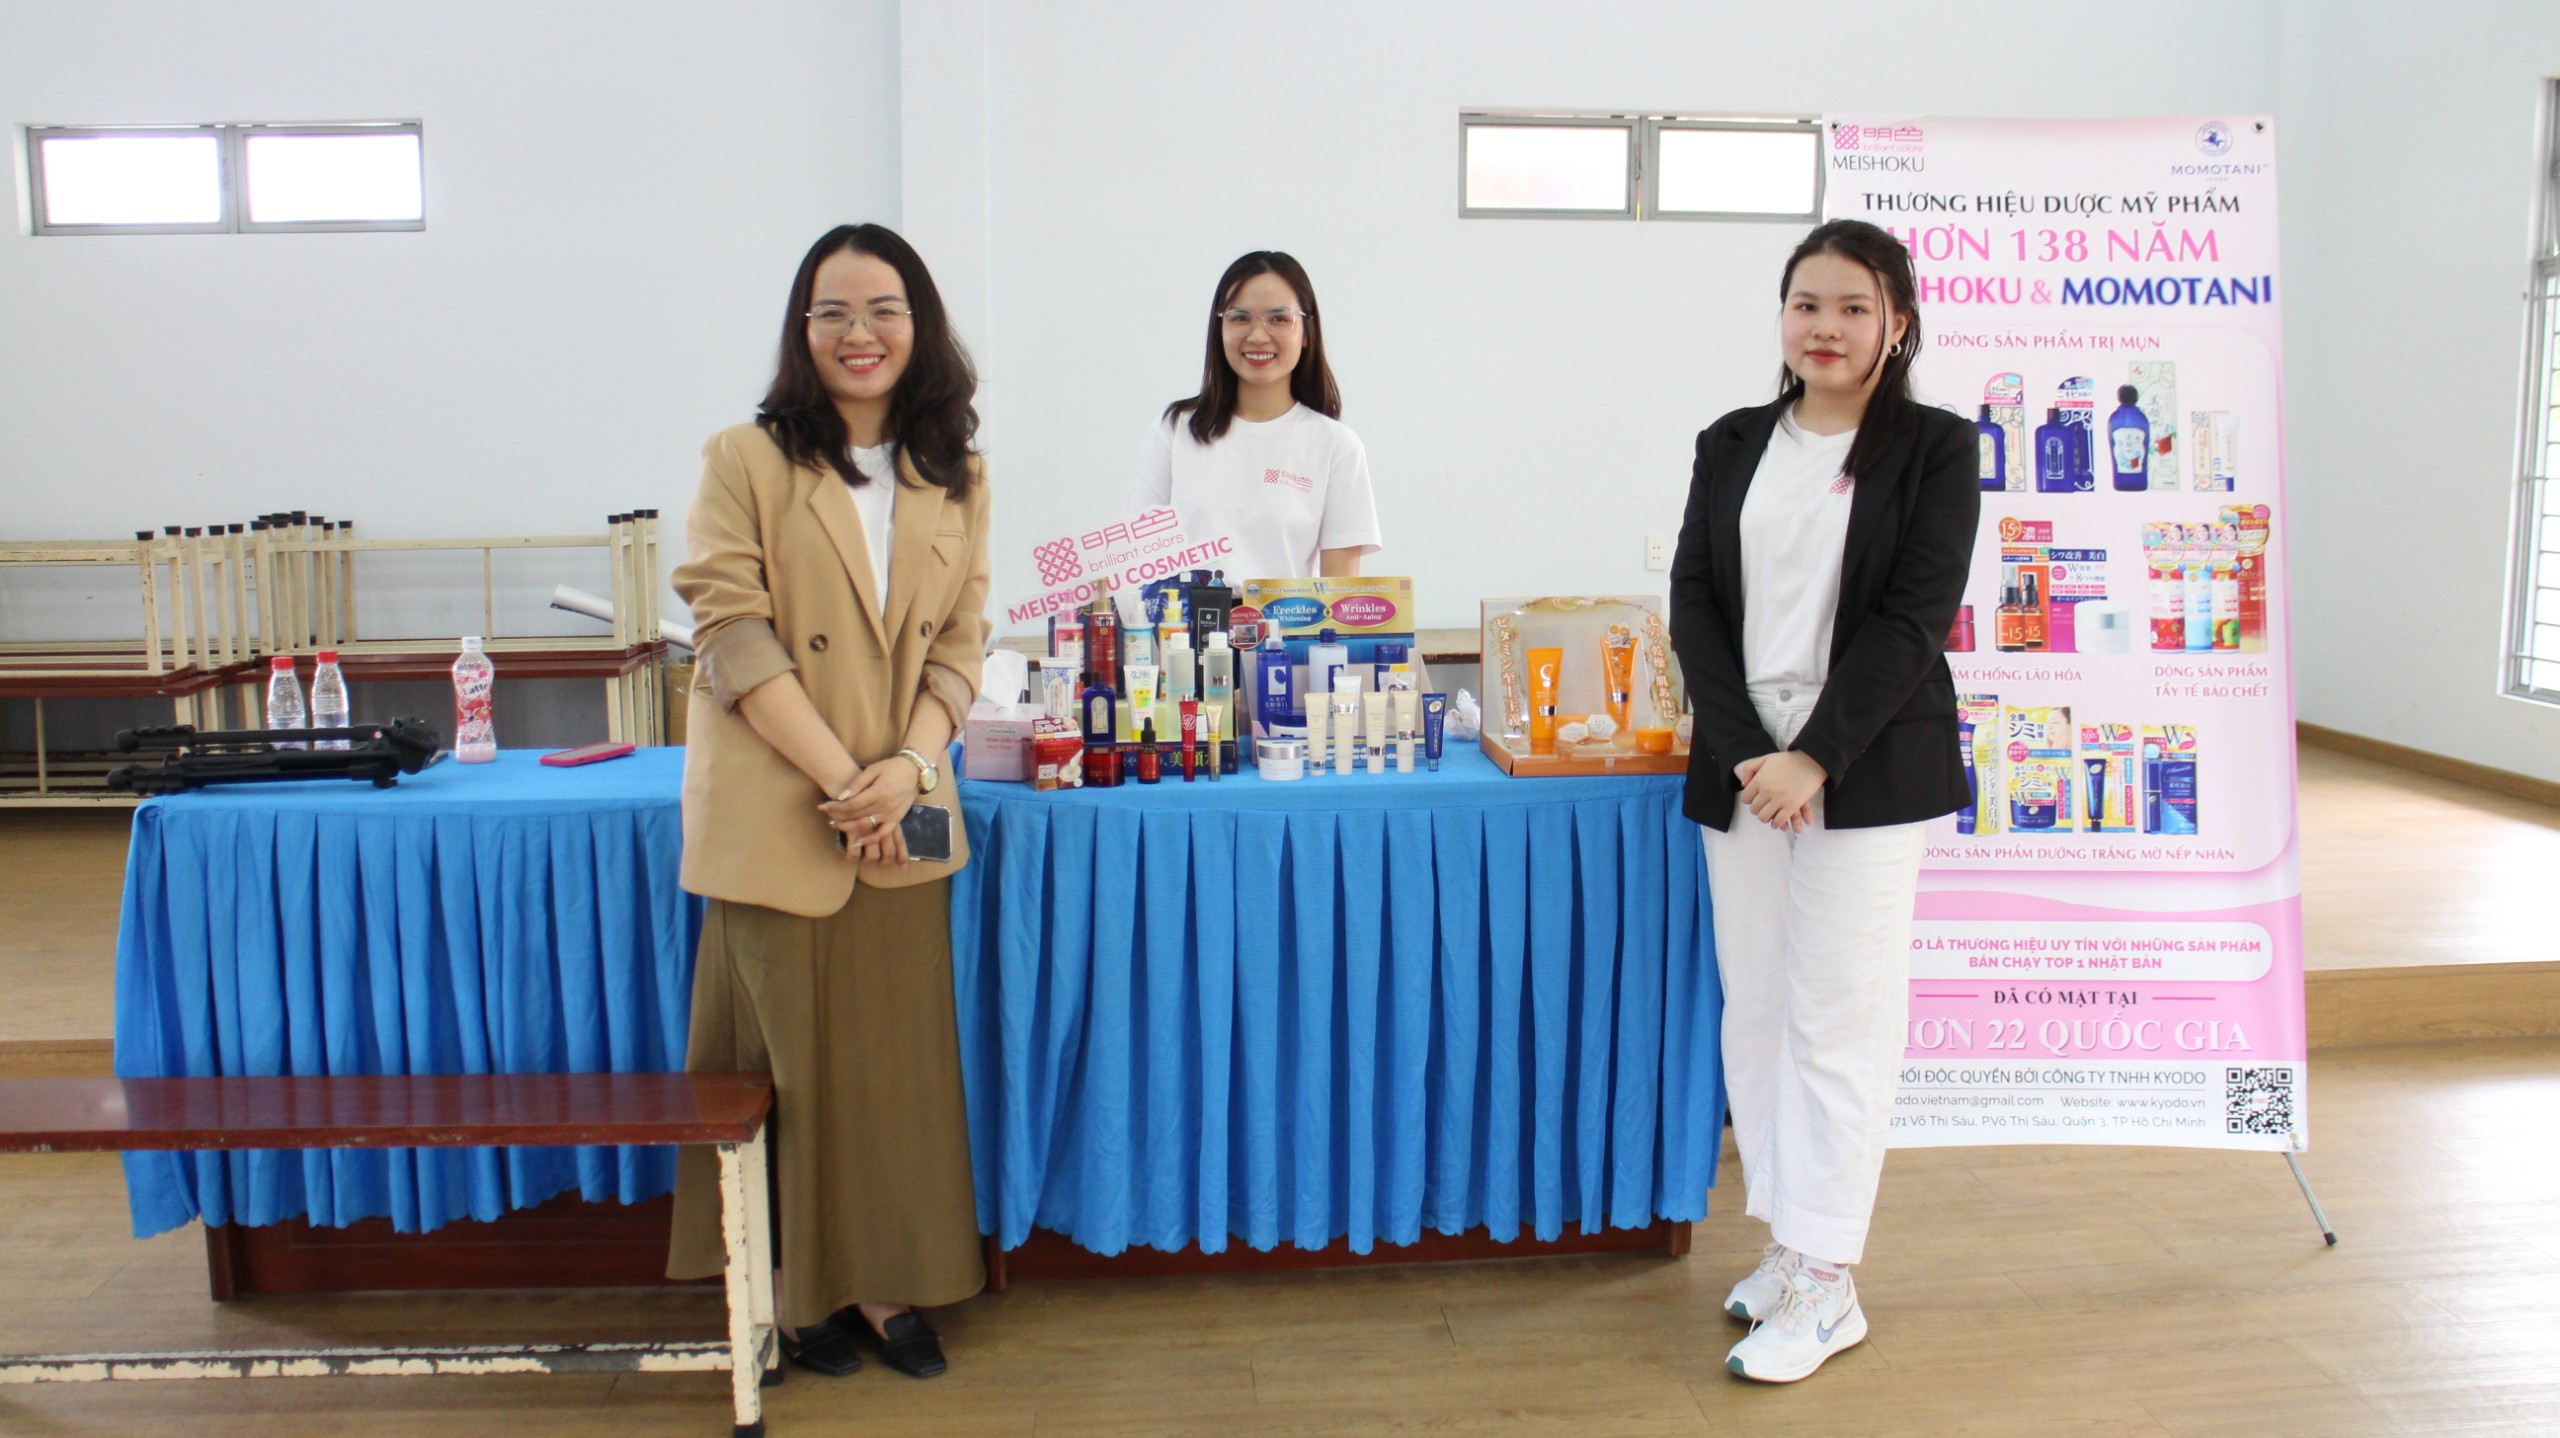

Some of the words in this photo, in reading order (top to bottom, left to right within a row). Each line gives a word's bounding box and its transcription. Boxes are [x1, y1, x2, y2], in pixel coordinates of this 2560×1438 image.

[1832, 155, 1925, 172] MEISHOKU
[1862, 191, 1967, 212] THƯƠNG
[1976, 190, 2035, 217] HIỆU
[2044, 192, 2112, 218] DƯỢC
[2121, 191, 2158, 213] MỸ
[2010, 229, 2088, 262] 138
[2107, 220, 2219, 262] NĂM
[1920, 276, 2022, 304] HOKU
[2031, 279, 2052, 304] &
[2062, 275, 2272, 305] MOMOTANI
[1937, 331, 1988, 348] DÒNG
[1994, 330, 2028, 348] SẢN
[2033, 329, 2083, 349] PHẨM
[2089, 336, 2114, 352] TRỊ
[2120, 336, 2160, 352] MỤN
[1088, 546, 1140, 572] brilliant
[1142, 534, 1185, 555] colors
[1125, 536, 1233, 585] COSMETIC
[1340, 603, 1387, 613] Wrinkles
[1950, 664, 1969, 680] ẨM
[1973, 665, 2022, 680] CHỐNG
[2026, 667, 2050, 681] LÃO
[2054, 667, 2082, 681] HÓA
[2154, 664, 2194, 677] DÒNG
[2198, 663, 2223, 677] SẢN
[462, 683, 488, 696] Latte
[2154, 681, 2179, 697] TẨY
[2184, 681, 2199, 697] TẾ
[2202, 684, 2229, 698] BÀO
[2232, 681, 2268, 697] CHẾT
[1964, 844, 1990, 858] SẢN
[1995, 843, 2033, 859] PHẨM
[2037, 846, 2086, 859] DƯỠNG
[2091, 844, 2136, 860] TRẮNG
[2140, 846, 2162, 860] MỜ
[2166, 845, 2191, 860] NẾP
[1927, 936, 1944, 950] LÀ
[1948, 938, 2010, 950] THƯƠNG
[2014, 936, 2047, 954] HIỆU
[2051, 939, 2070, 951] UY
[2074, 937, 2098, 951] TÍN
[2101, 937, 2126, 951] VỚI
[2131, 937, 2184, 951] NHỮNG
[2188, 937, 2216, 952] SẢN
[1969, 954, 1998, 968] BÁN
[2002, 956, 2041, 971] CHẠY
[2044, 957, 2074, 968] TOP
[2077, 959, 2085, 968] 1
[2088, 954, 2128, 971] NHẬT
[2131, 954, 2162, 968] BẢN
[1994, 987, 2020, 1004] ĐÃ
[2025, 987, 2052, 1004] CÓ
[2057, 989, 2099, 1007] MẶT
[2105, 991, 2138, 1007] TẠI
[1986, 1018, 2027, 1050] 22
[2038, 1012, 2163, 1057] QUỐC
[2174, 1020, 2252, 1051] GIA
[1924, 1068, 1957, 1086] ĐỘC
[2015, 1067, 2039, 1083] BỞI
[2042, 1068, 2085, 1084] CÔNG
[2088, 1071, 2106, 1083] TY
[2109, 1071, 2150, 1083] TNHH
[2154, 1071, 2206, 1084] KYODO
[1894, 1094, 2044, 1108] odo.vietnam@gmail.com
[2117, 1097, 2205, 1110] www.kyodo.vn
[1909, 1115, 1926, 1126] Võ
[1929, 1115, 1948, 1128] Thị
[2010, 1116, 2029, 1128] Thị
[2062, 1116, 2095, 1128] Quận
[2131, 1116, 2149, 1127] Hồ
[2152, 1116, 2172, 1127] Chí
[2175, 1116, 2206, 1127] Minh
